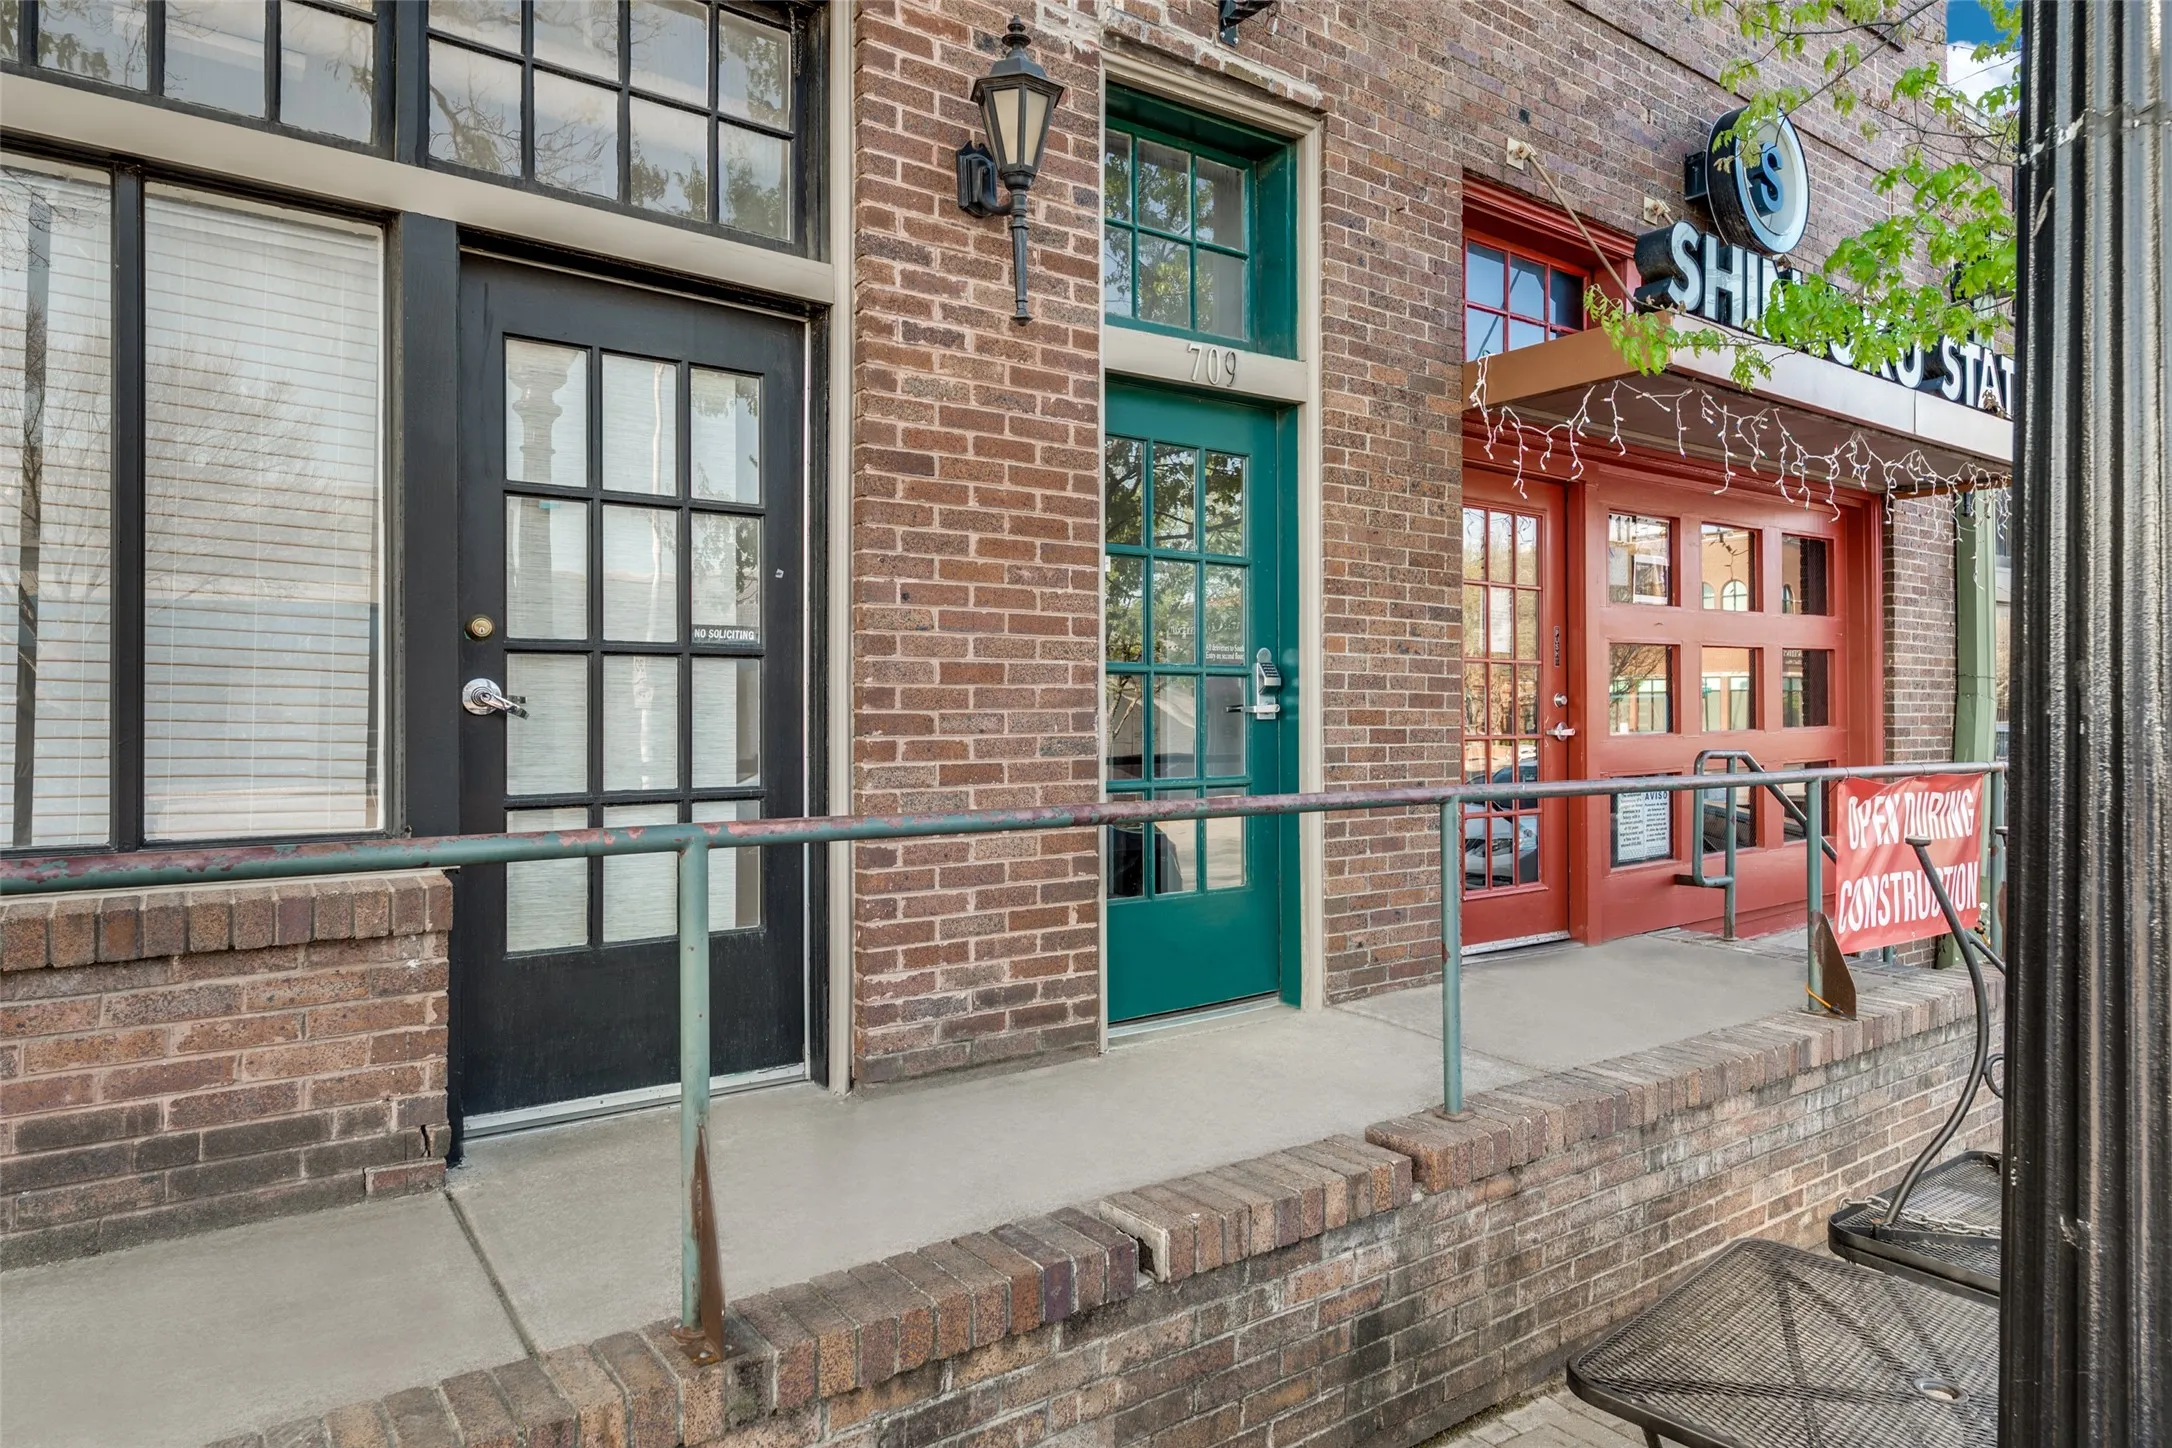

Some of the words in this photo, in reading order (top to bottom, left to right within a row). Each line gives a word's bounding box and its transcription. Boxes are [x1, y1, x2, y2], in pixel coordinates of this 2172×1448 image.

[1760, 141, 1784, 213] S
[1187, 343, 1236, 387] 709
[694, 628, 706, 638] NO
[708, 629, 755, 640] SOLICITING
[1645, 791, 1668, 800] AVISO
[1848, 794, 1900, 850] OPEN
[1904, 788, 1975, 842] DURING
